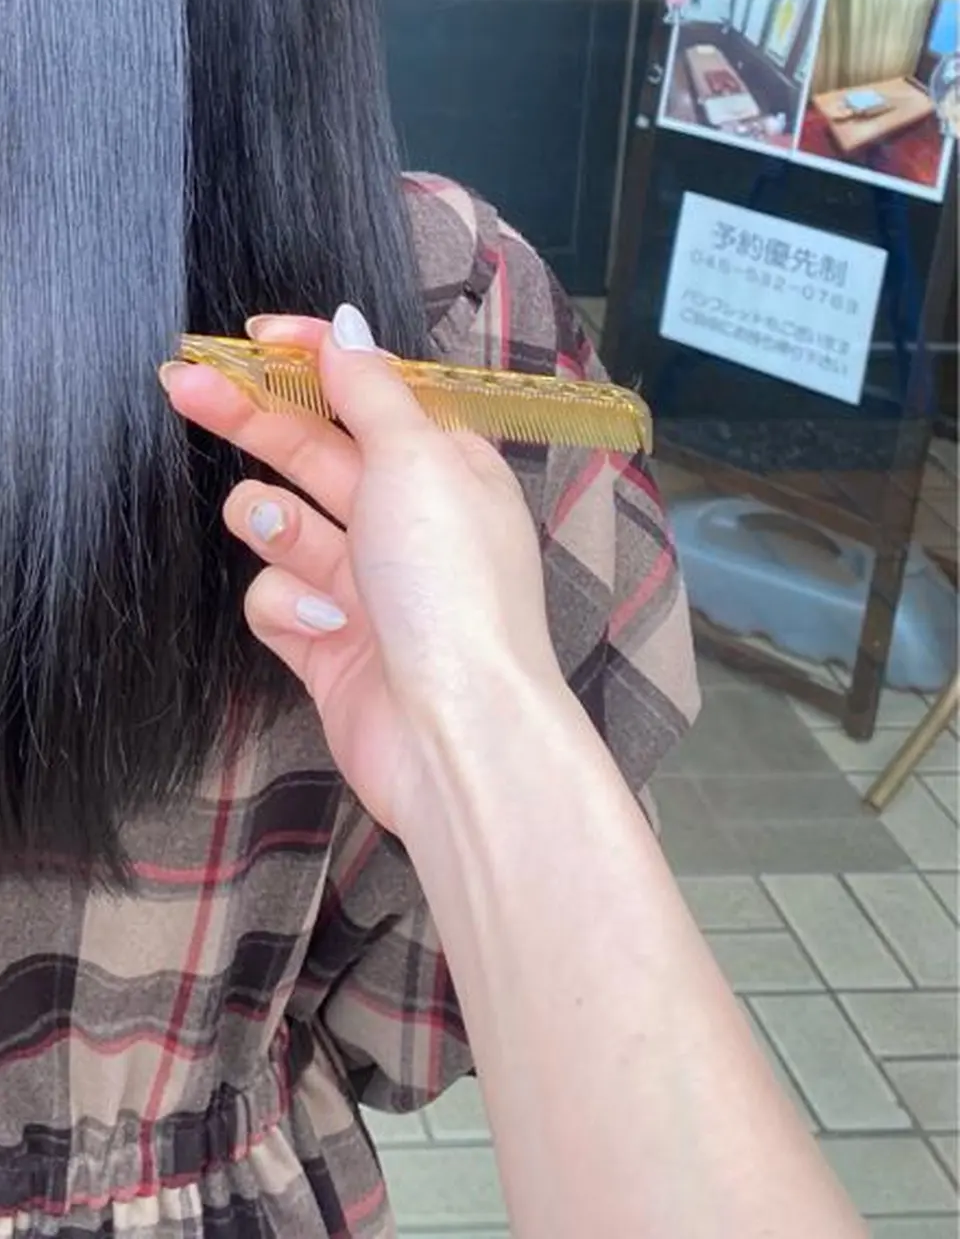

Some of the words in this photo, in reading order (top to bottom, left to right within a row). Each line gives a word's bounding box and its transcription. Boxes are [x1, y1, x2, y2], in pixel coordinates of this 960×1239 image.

[711, 220, 848, 288] 予約優先制
